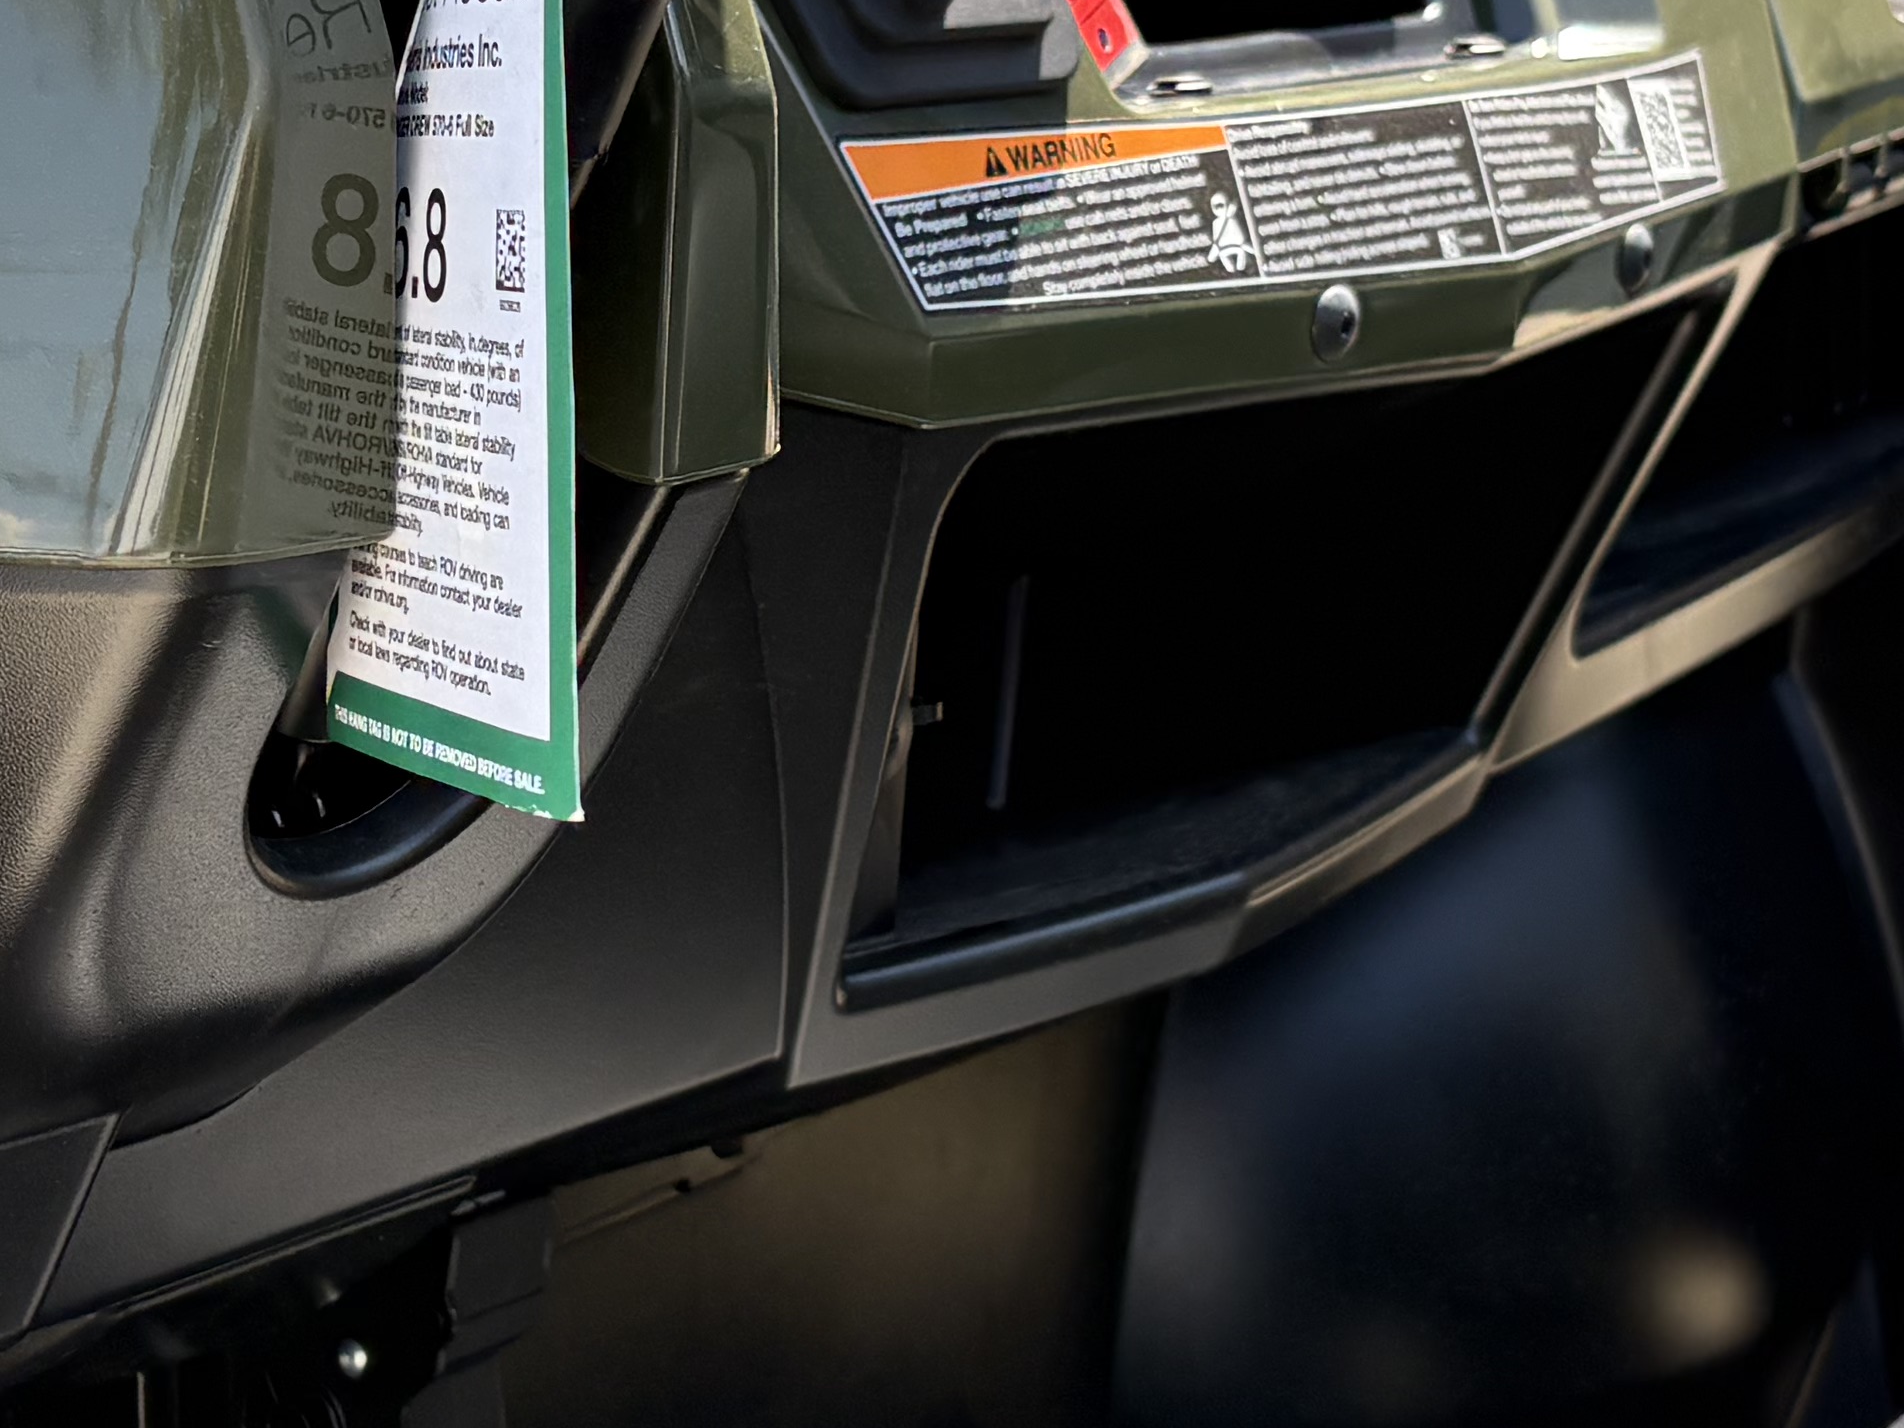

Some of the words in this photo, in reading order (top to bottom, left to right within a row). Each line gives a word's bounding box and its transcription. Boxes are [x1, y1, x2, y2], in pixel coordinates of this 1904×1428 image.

[478, 33, 502, 69] Inc.
[455, 113, 471, 138] Full
[475, 113, 495, 138] Size
[1005, 133, 1117, 172] WARNING
[409, 733, 422, 753] TO
[422, 737, 435, 758] BE
[513, 769, 546, 795] SALE.
